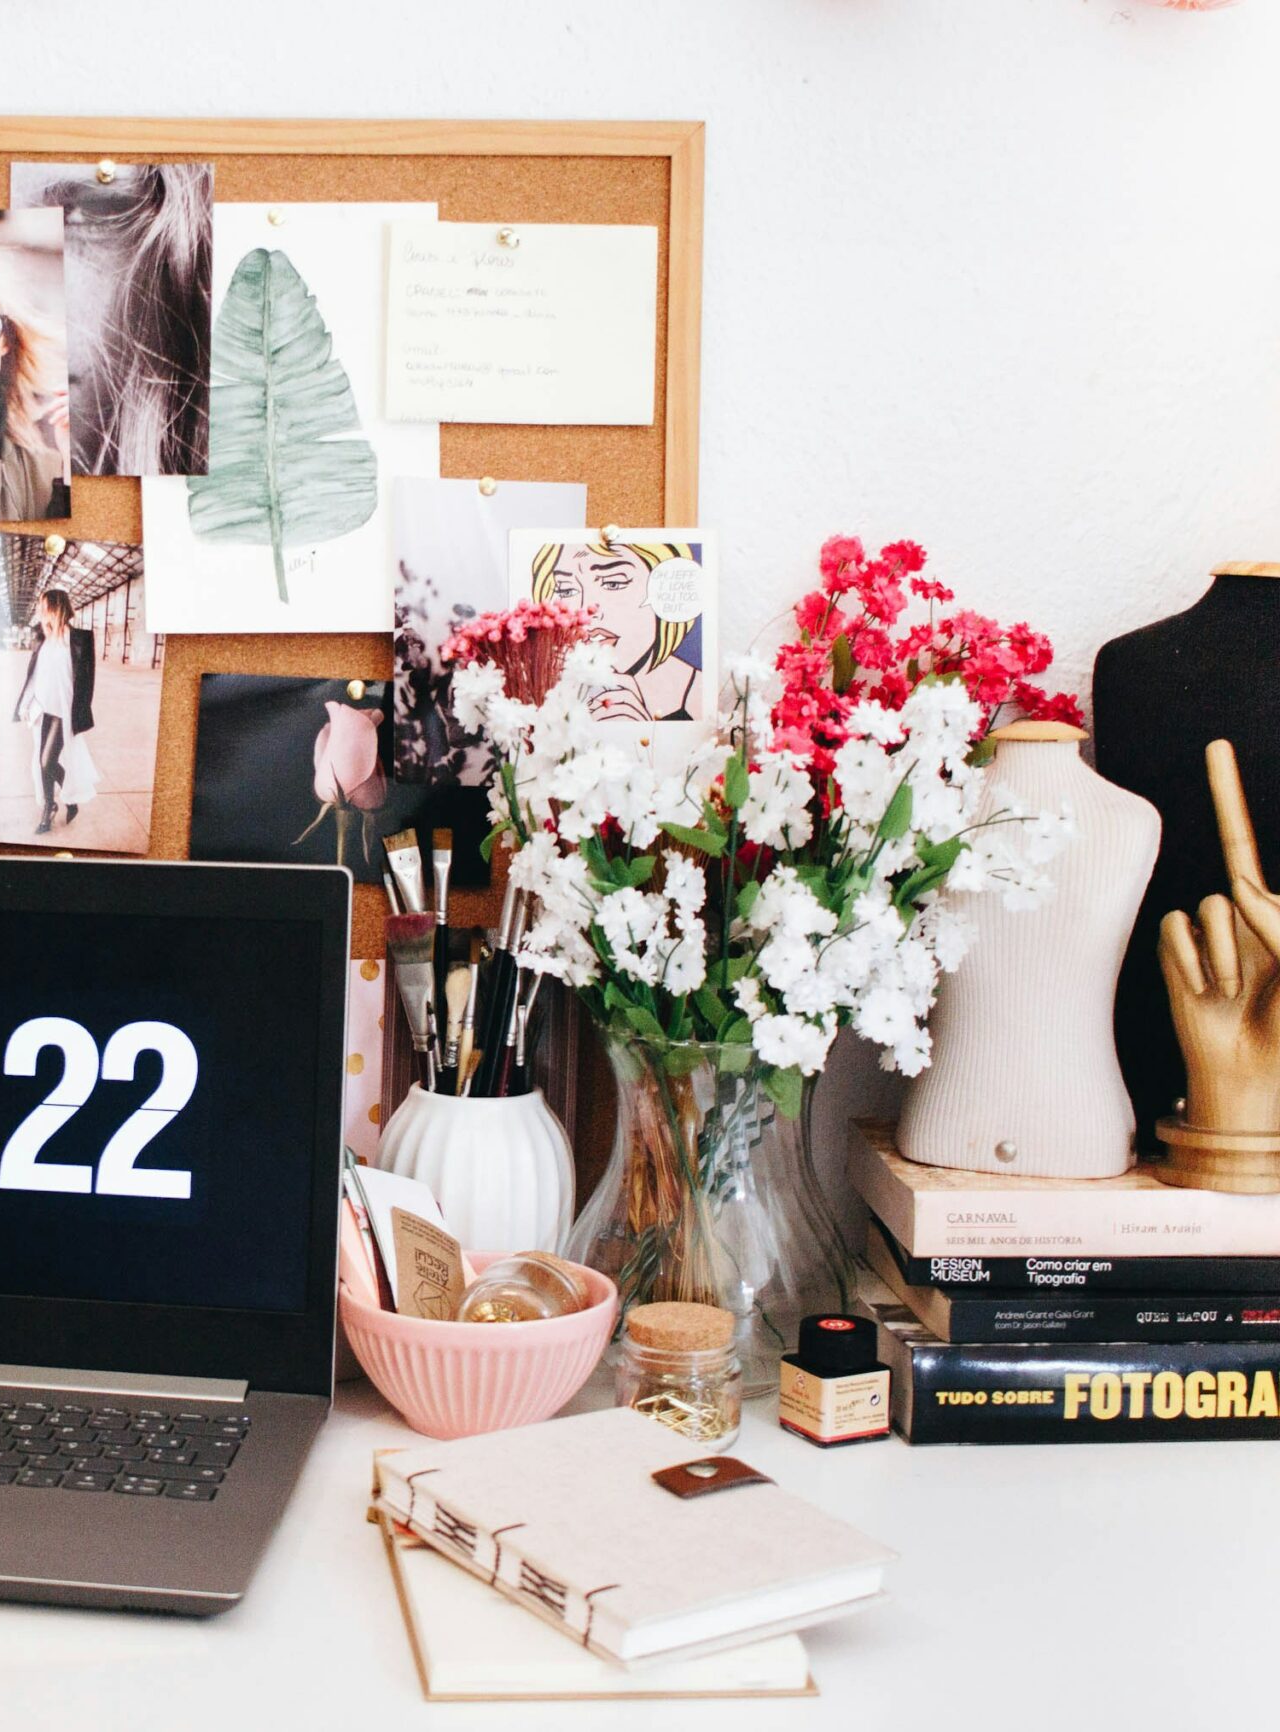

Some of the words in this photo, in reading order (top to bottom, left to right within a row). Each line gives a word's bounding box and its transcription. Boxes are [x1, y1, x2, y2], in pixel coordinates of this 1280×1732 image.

[946, 1213, 1018, 1225] CARNAVAL
[946, 1237, 966, 1245] SEIS
[969, 1237, 986, 1245] MIL
[990, 1237, 1018, 1246] ANOS
[930, 1258, 982, 1270] DESIGN
[1026, 1258, 1063, 1271] Como
[1064, 1259, 1091, 1271] criar
[1092, 1261, 1112, 1272] em
[930, 1270, 990, 1282] MUSEUM
[1026, 1271, 1086, 1287] Tipografia
[995, 1311, 1025, 1320] Andrew
[1025, 1311, 1048, 1320] Grant
[1072, 1310, 1095, 1319] Grant
[1136, 1311, 1170, 1324] QUEM
[1176, 1310, 1218, 1322] MATOU
[936, 1391, 988, 1405] TUDO
[992, 1390, 1055, 1405] SOBRE
[1063, 1370, 1280, 1420] FOTOGRA
